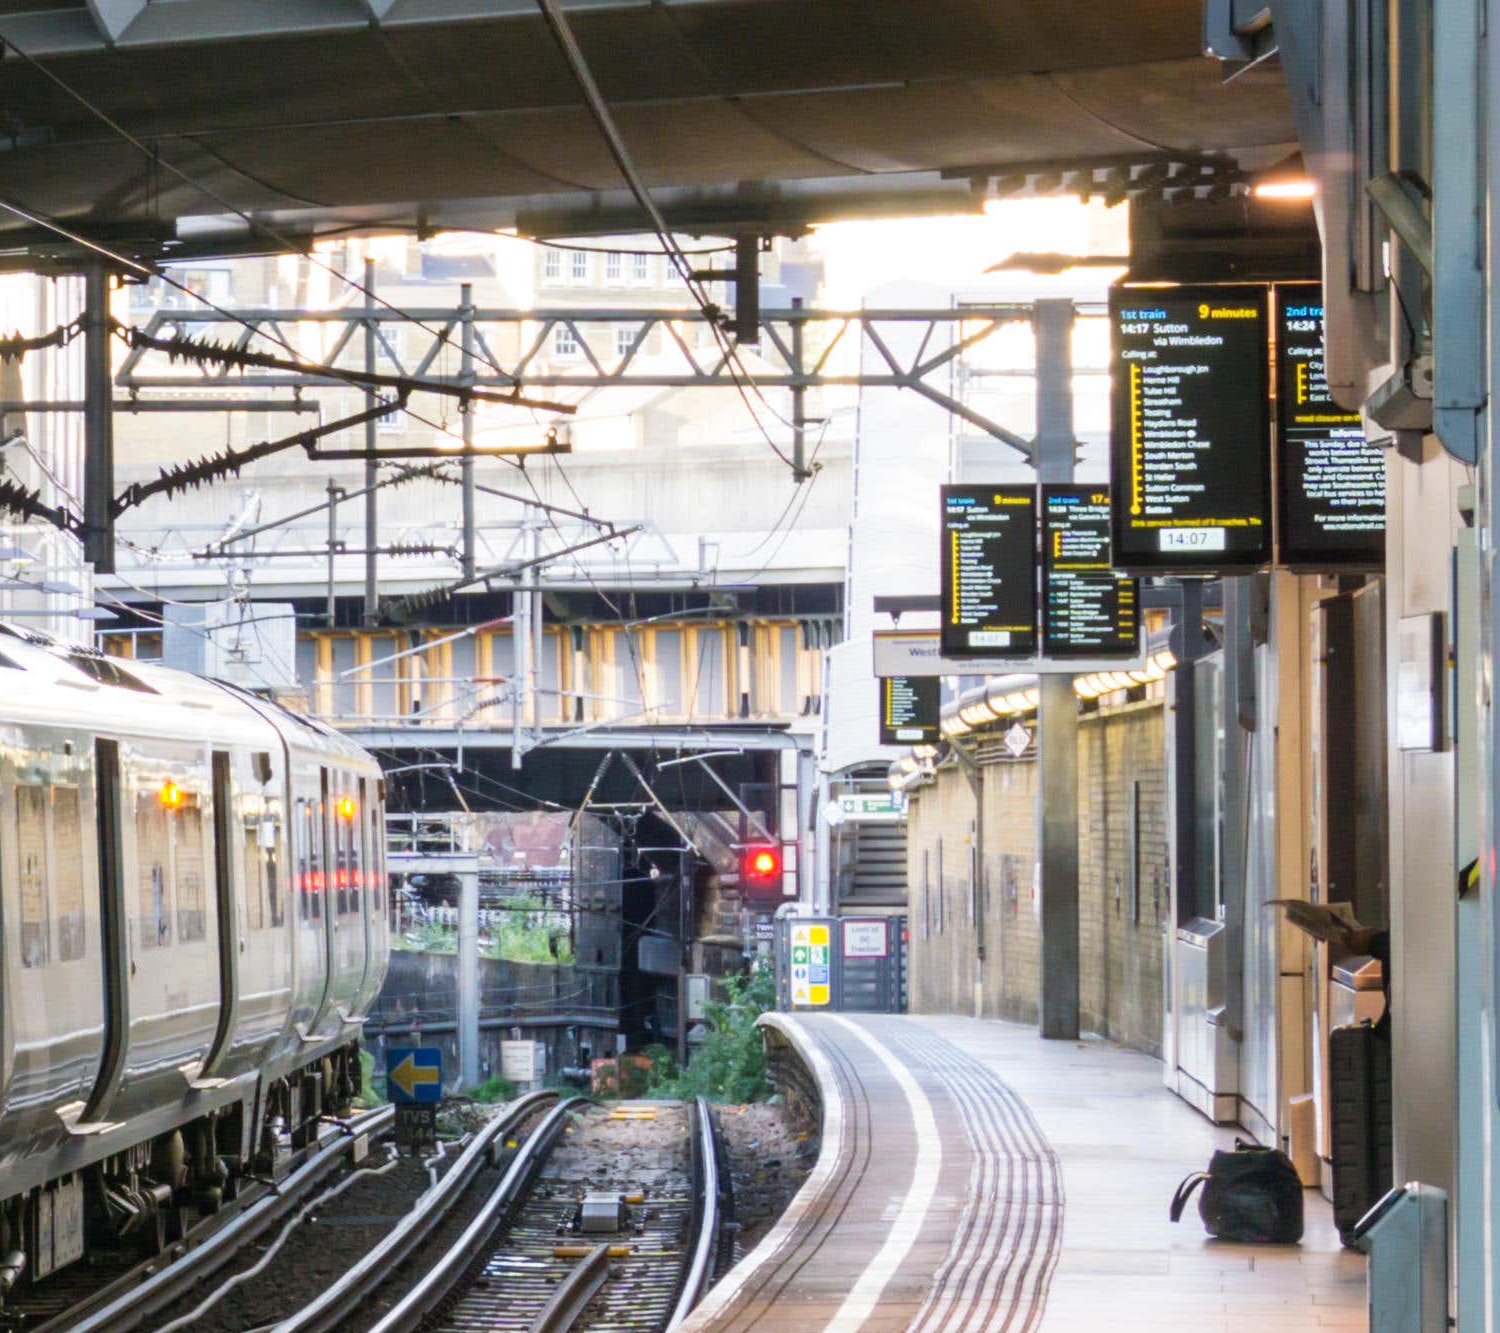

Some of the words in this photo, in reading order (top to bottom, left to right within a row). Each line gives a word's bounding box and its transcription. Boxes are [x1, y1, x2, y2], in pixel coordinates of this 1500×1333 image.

[1121, 309, 1137, 320] 1st
[1139, 309, 1166, 319] train
[1198, 304, 1210, 319] 9
[1211, 308, 1257, 318] minutes
[1285, 306, 1307, 317] 2nd
[1121, 323, 1149, 334] 14:17
[1153, 323, 1189, 334] Sutton
[1286, 321, 1316, 331] 14:24
[1153, 337, 1168, 346] via
[1169, 335, 1223, 346] Wimbledon
[1121, 350, 1147, 360] Calling
[1145, 506, 1172, 514] Sutton
[1168, 533, 1208, 545] 14:07
